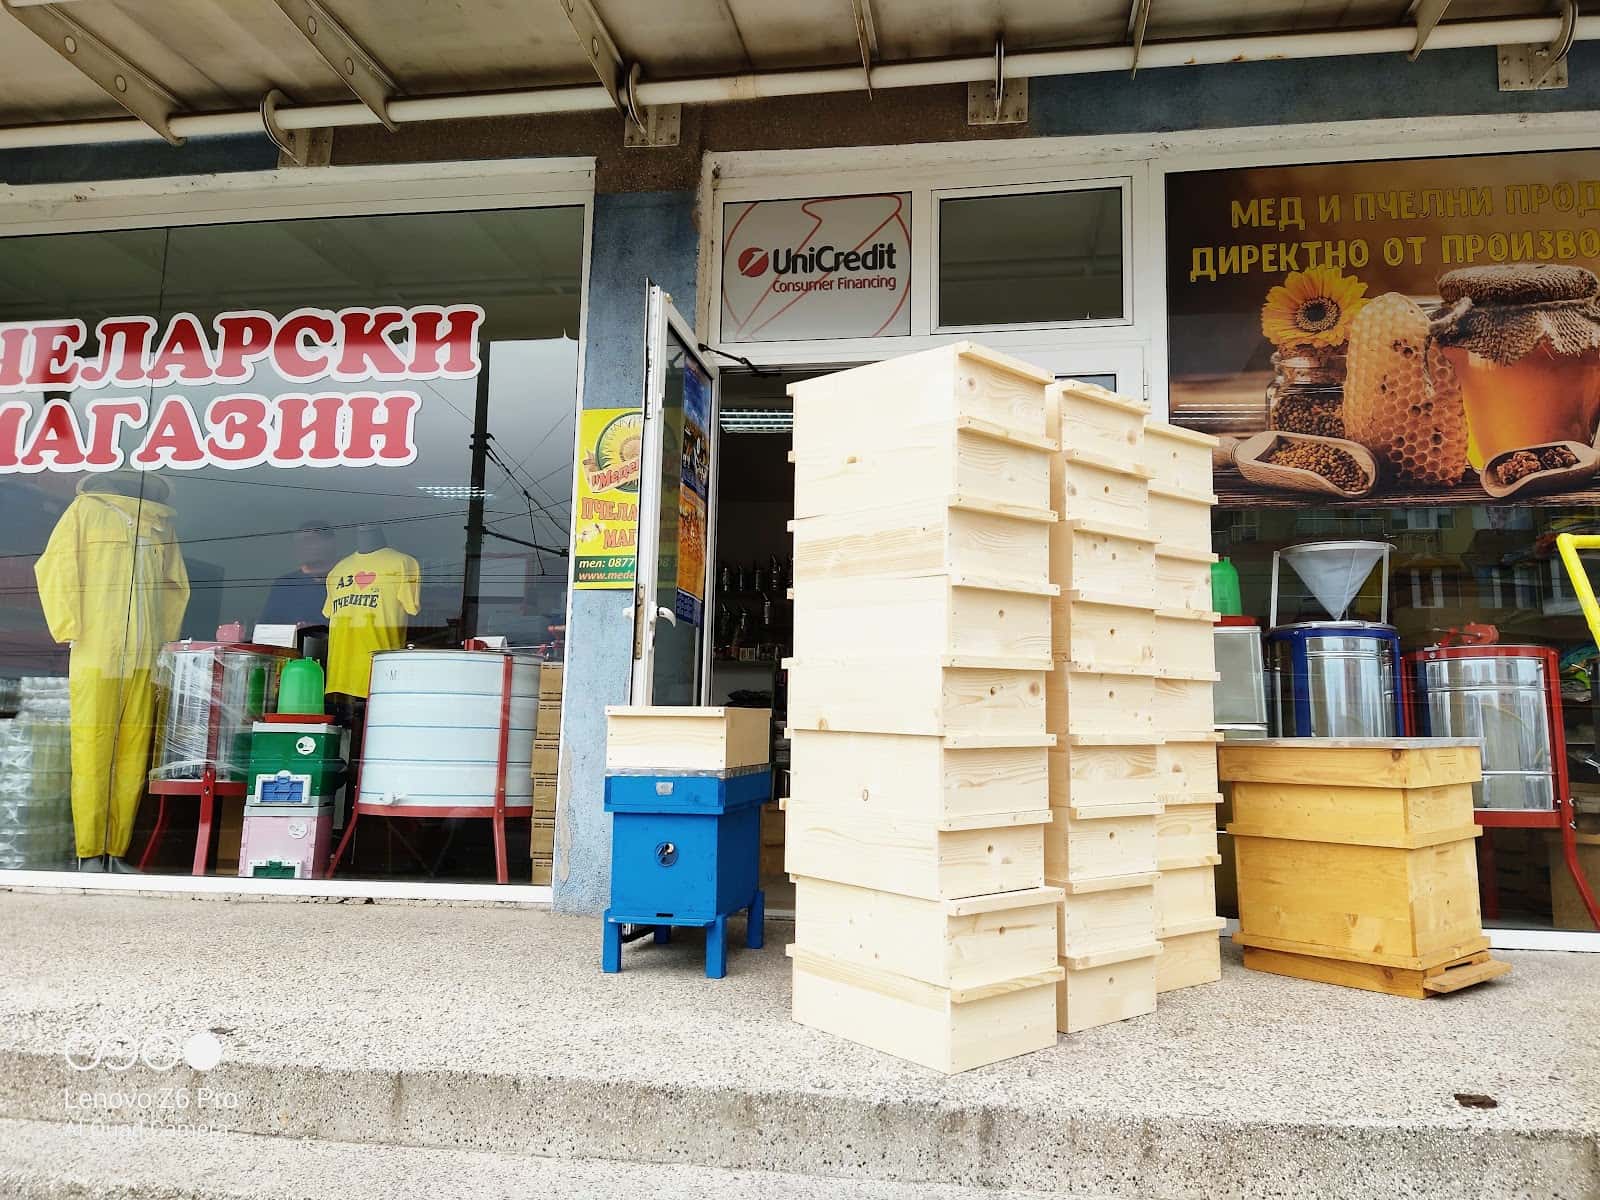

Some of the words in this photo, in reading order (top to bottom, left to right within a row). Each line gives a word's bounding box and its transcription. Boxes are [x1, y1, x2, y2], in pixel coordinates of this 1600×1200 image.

[1231, 196, 1305, 232] МЕД
[1318, 194, 1341, 224] И
[1352, 185, 1495, 222] ПЧЕЛНИ
[1505, 180, 1600, 217] ПРОД
[772, 242, 897, 275] UniCredit
[1190, 239, 1369, 283] ДИРЕКТНО
[1383, 235, 1428, 267] ОТ
[1440, 227, 1600, 265] ПРОИЗВО
[772, 280, 834, 293] Consumer
[837, 275, 896, 291] Financing
[579, 560, 605, 568] тел:
[608, 557, 635, 568] 0877
[336, 575, 354, 589] АЗ
